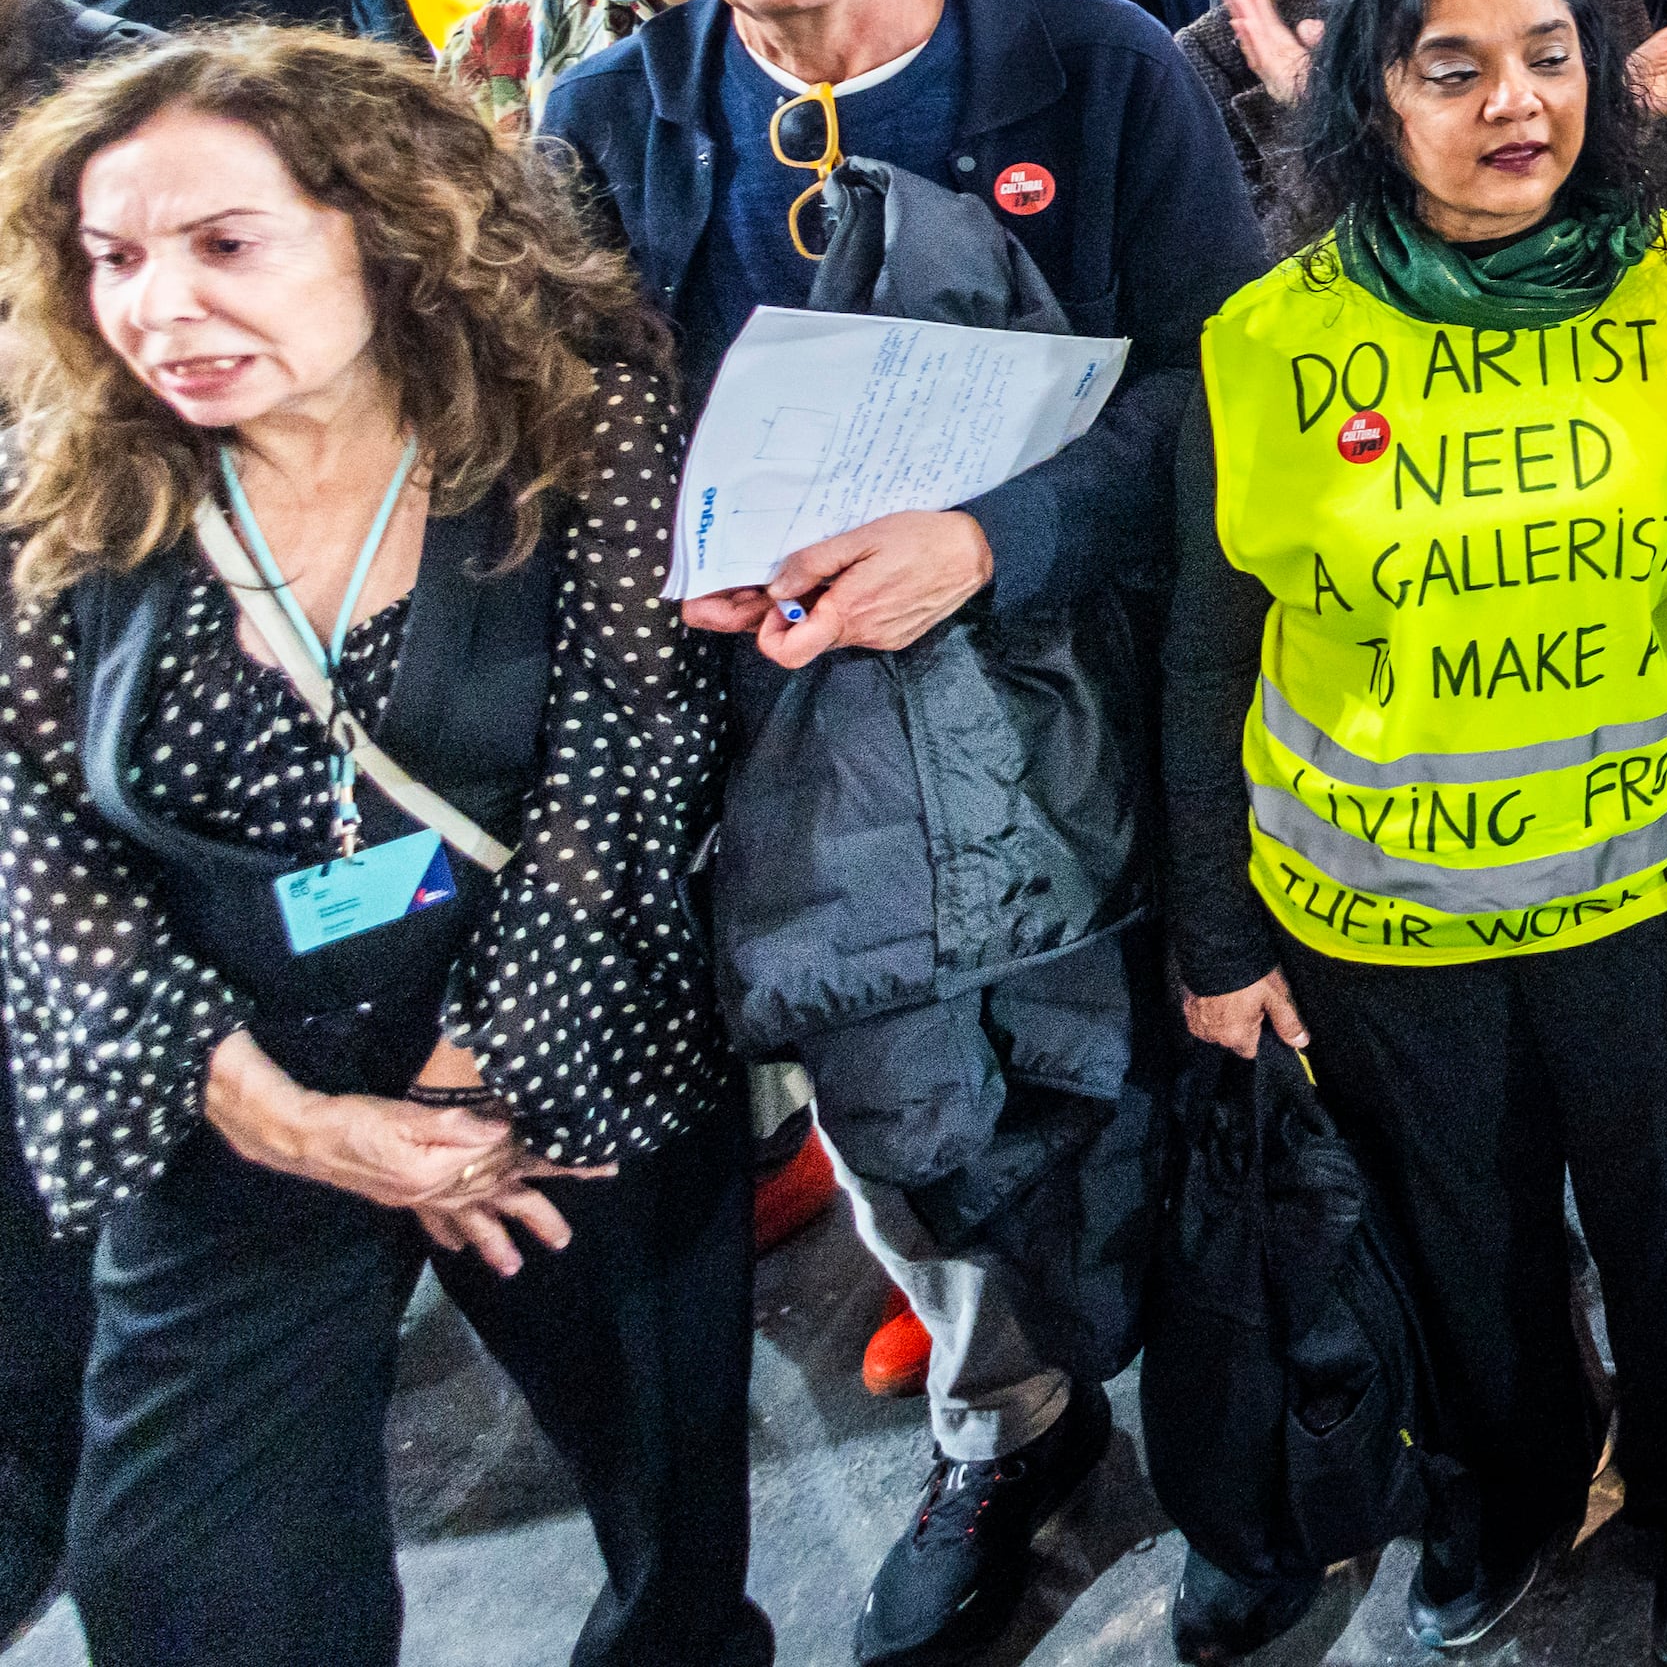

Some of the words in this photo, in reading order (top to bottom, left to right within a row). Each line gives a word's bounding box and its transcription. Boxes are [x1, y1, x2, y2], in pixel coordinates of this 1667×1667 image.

[1292, 341, 1390, 434] DO
[1395, 419, 1612, 510] NEED
[1315, 553, 1353, 615] A
[1356, 637, 1395, 708] TO
[1432, 624, 1607, 699] MAKE
